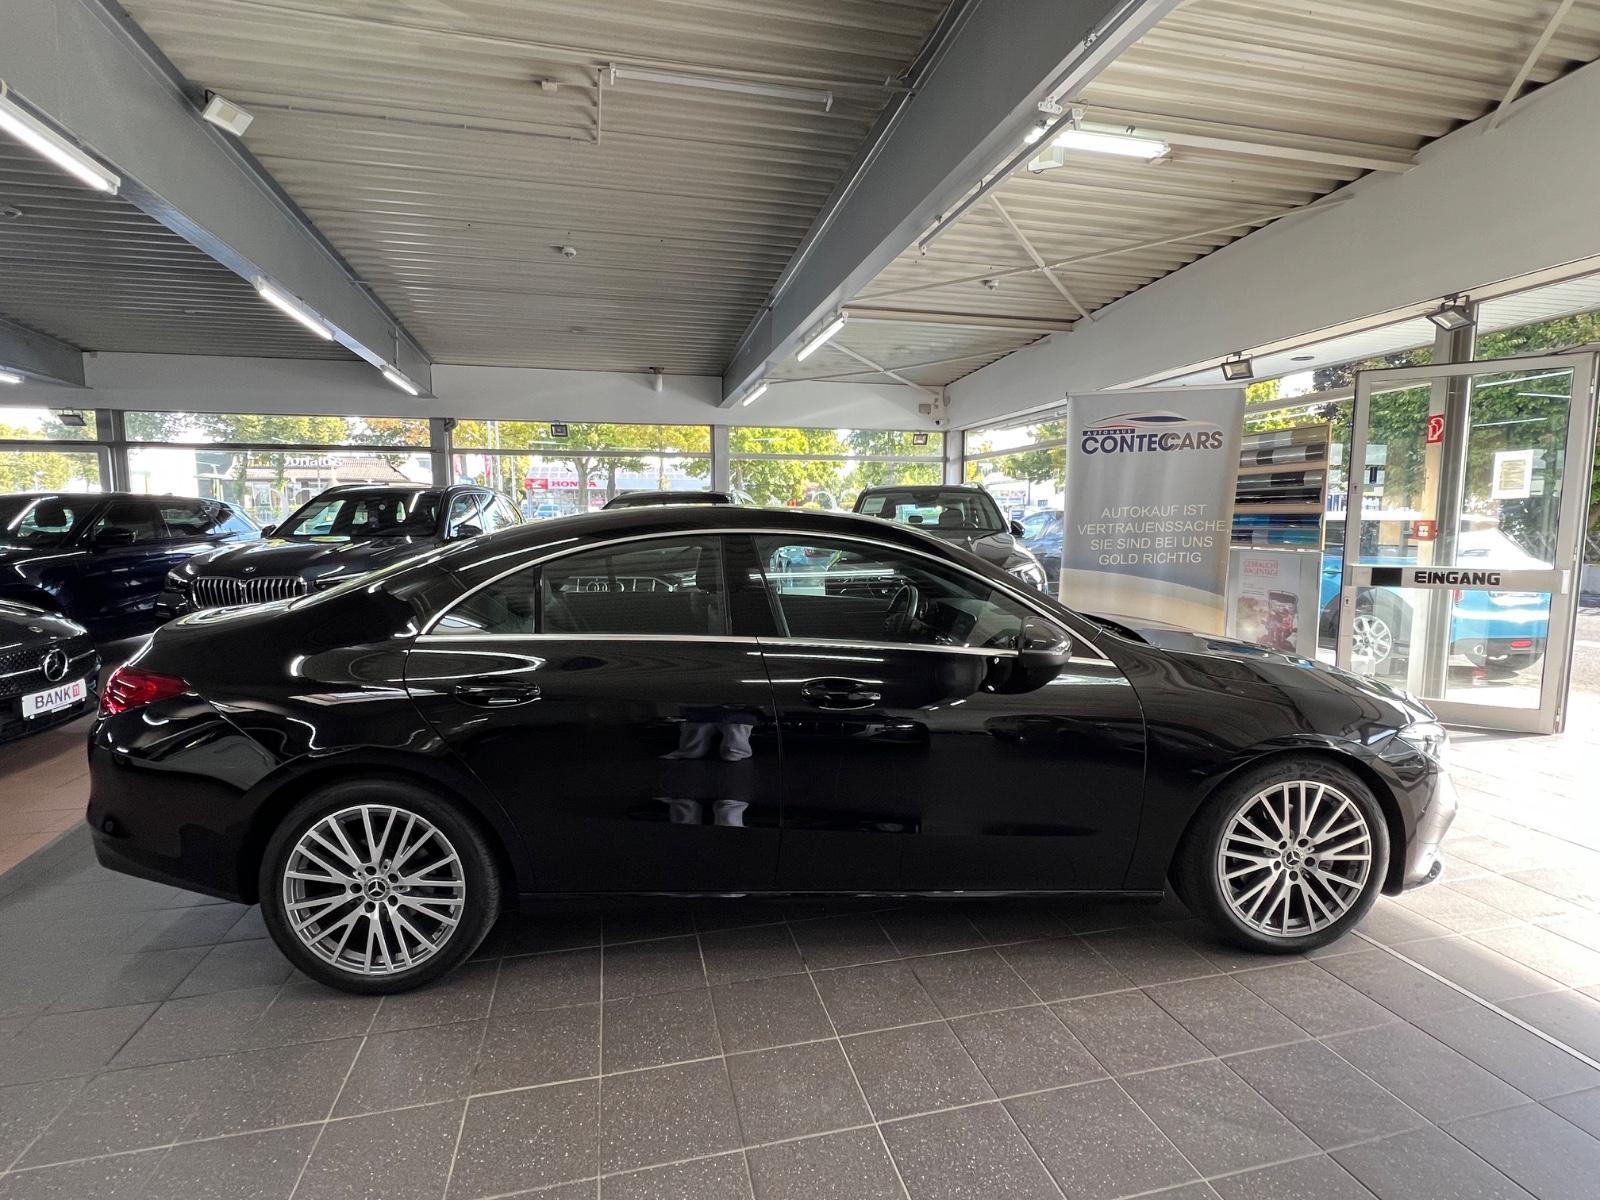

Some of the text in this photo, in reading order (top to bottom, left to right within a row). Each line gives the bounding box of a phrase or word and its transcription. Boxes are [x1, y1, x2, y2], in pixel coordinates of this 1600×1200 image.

[551, 480, 597, 488] HONA
[1100, 503, 1207, 519] AUTOKAUF IST
[1077, 519, 1230, 535] VERTRAUENSSACHE,
[1090, 535, 1213, 551] SIE SIND BEI UNS
[1098, 551, 1202, 566] GOLD RICHTIG
[1414, 571, 1501, 586] EINGANG
